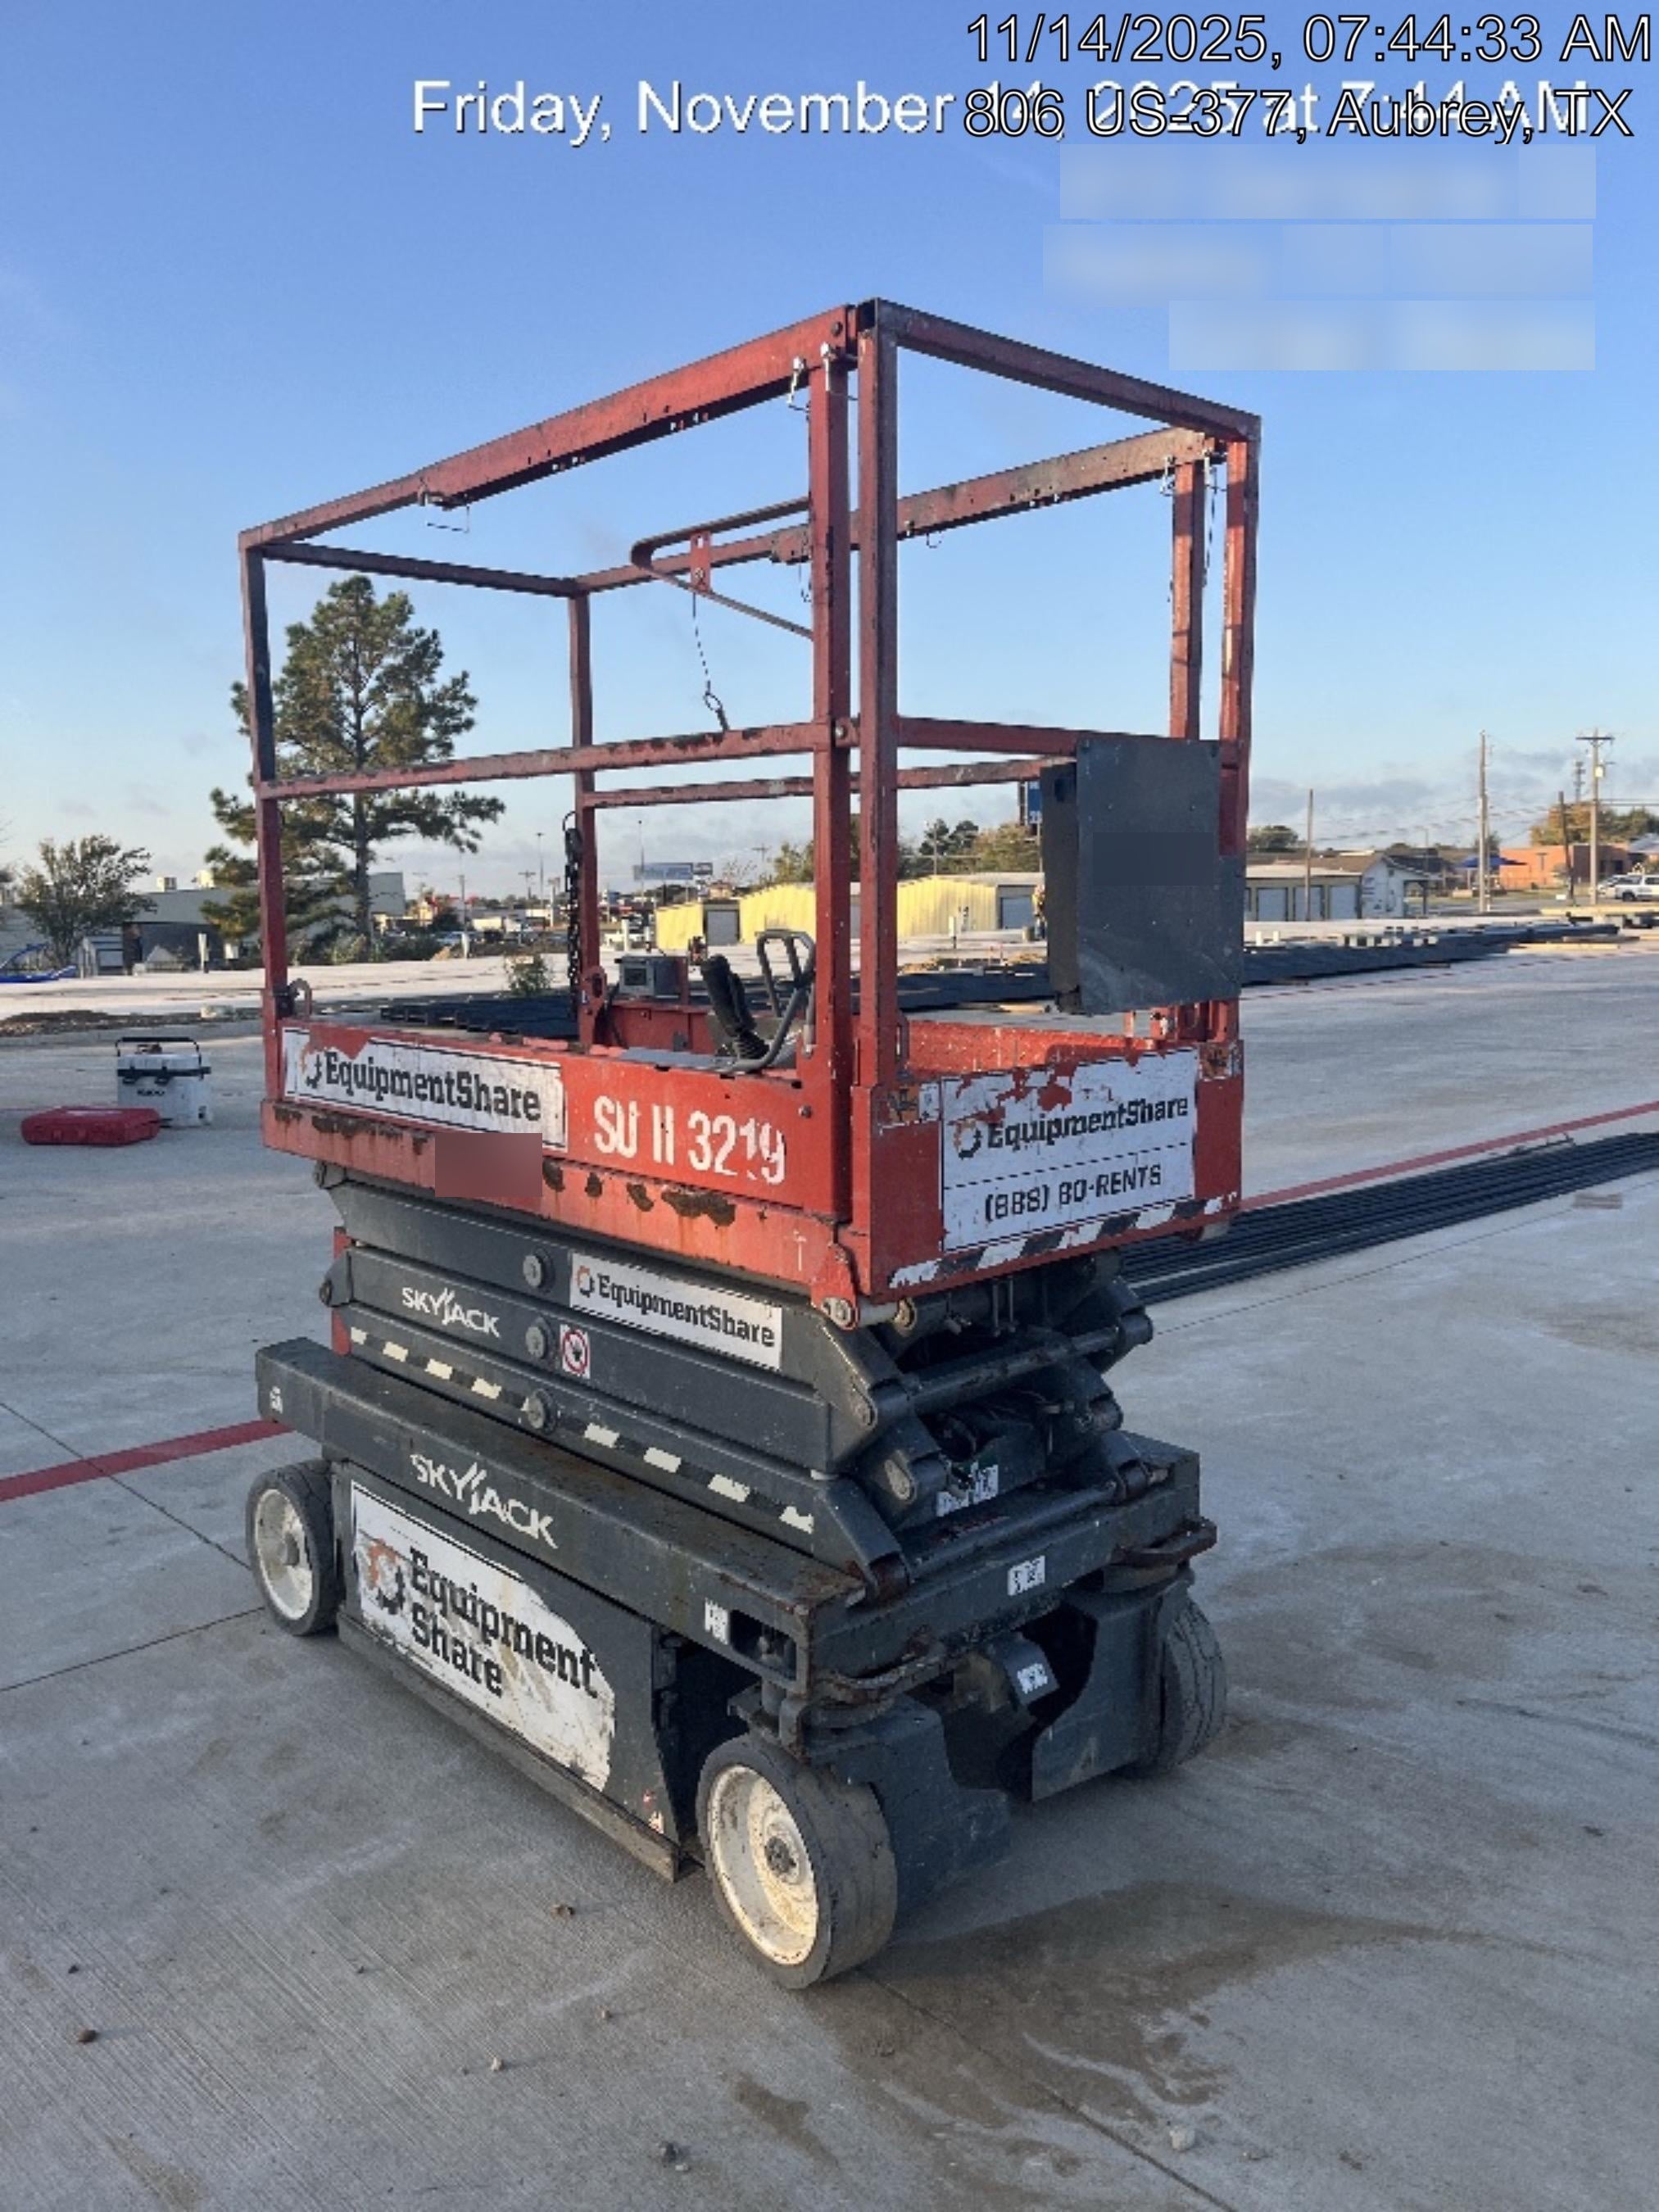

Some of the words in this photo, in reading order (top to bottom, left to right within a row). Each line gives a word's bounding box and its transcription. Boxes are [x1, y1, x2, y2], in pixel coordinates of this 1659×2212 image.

[324, 1052, 542, 1121] EquipmentShare
[987, 1097, 1188, 1152] EquipmentShare
[402, 1287, 500, 1338] SKYJACK
[598, 1272, 775, 1347] EquipmentShare
[410, 1453, 559, 1549] SKYJACK
[410, 1546, 598, 1698] Equipment
[411, 1601, 502, 1698] Share
